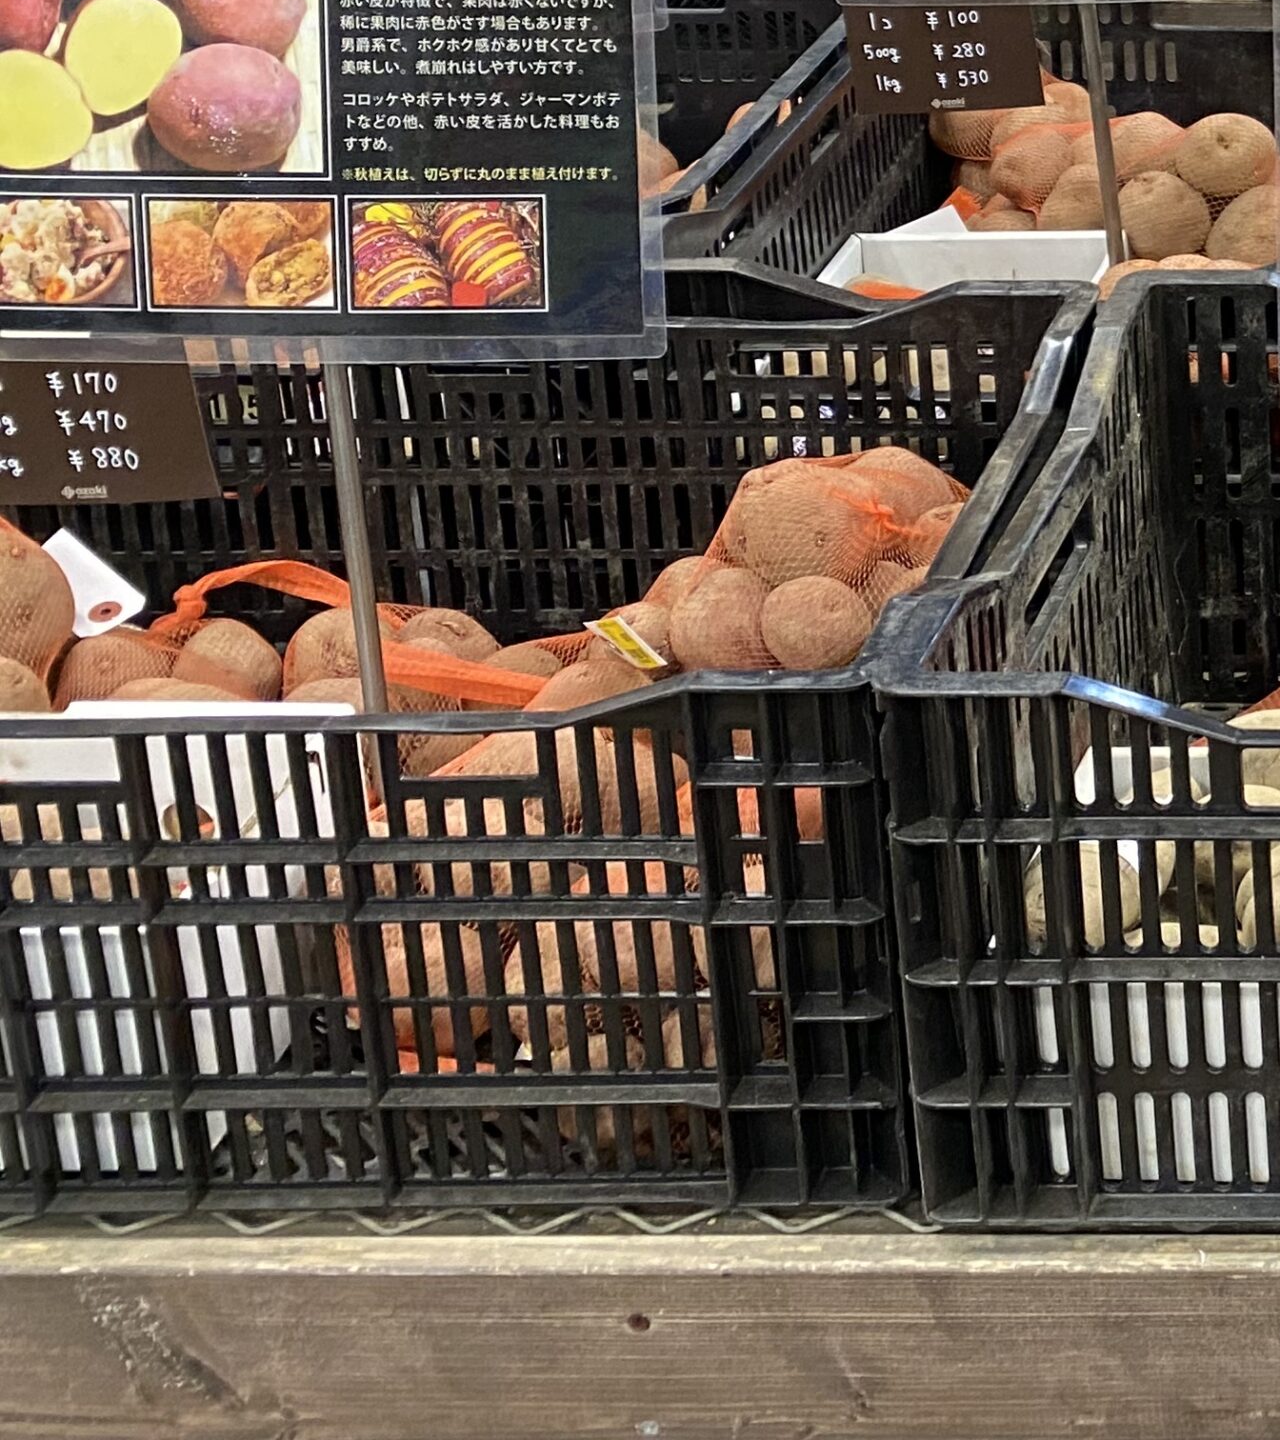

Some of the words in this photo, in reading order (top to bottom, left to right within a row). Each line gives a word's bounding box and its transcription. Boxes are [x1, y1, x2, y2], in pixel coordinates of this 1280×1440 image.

[340, 15, 599, 31] 稀に果肉に赤色がさす場合もあります。
[340, 37, 617, 53] 男爵系で、ホクホク感があり甘くてとても
[863, 44, 901, 63] 500g
[341, 60, 585, 76] 美味しい。煮崩れはしやすい方です。
[875, 74, 902, 93] 1kg
[343, 92, 621, 107] コロッケやポテトサラダ、ジャーマンポテ
[345, 114, 620, 129] トなどの他、赤い皮を活かした料理もお
[344, 136, 394, 152] すすめ。
